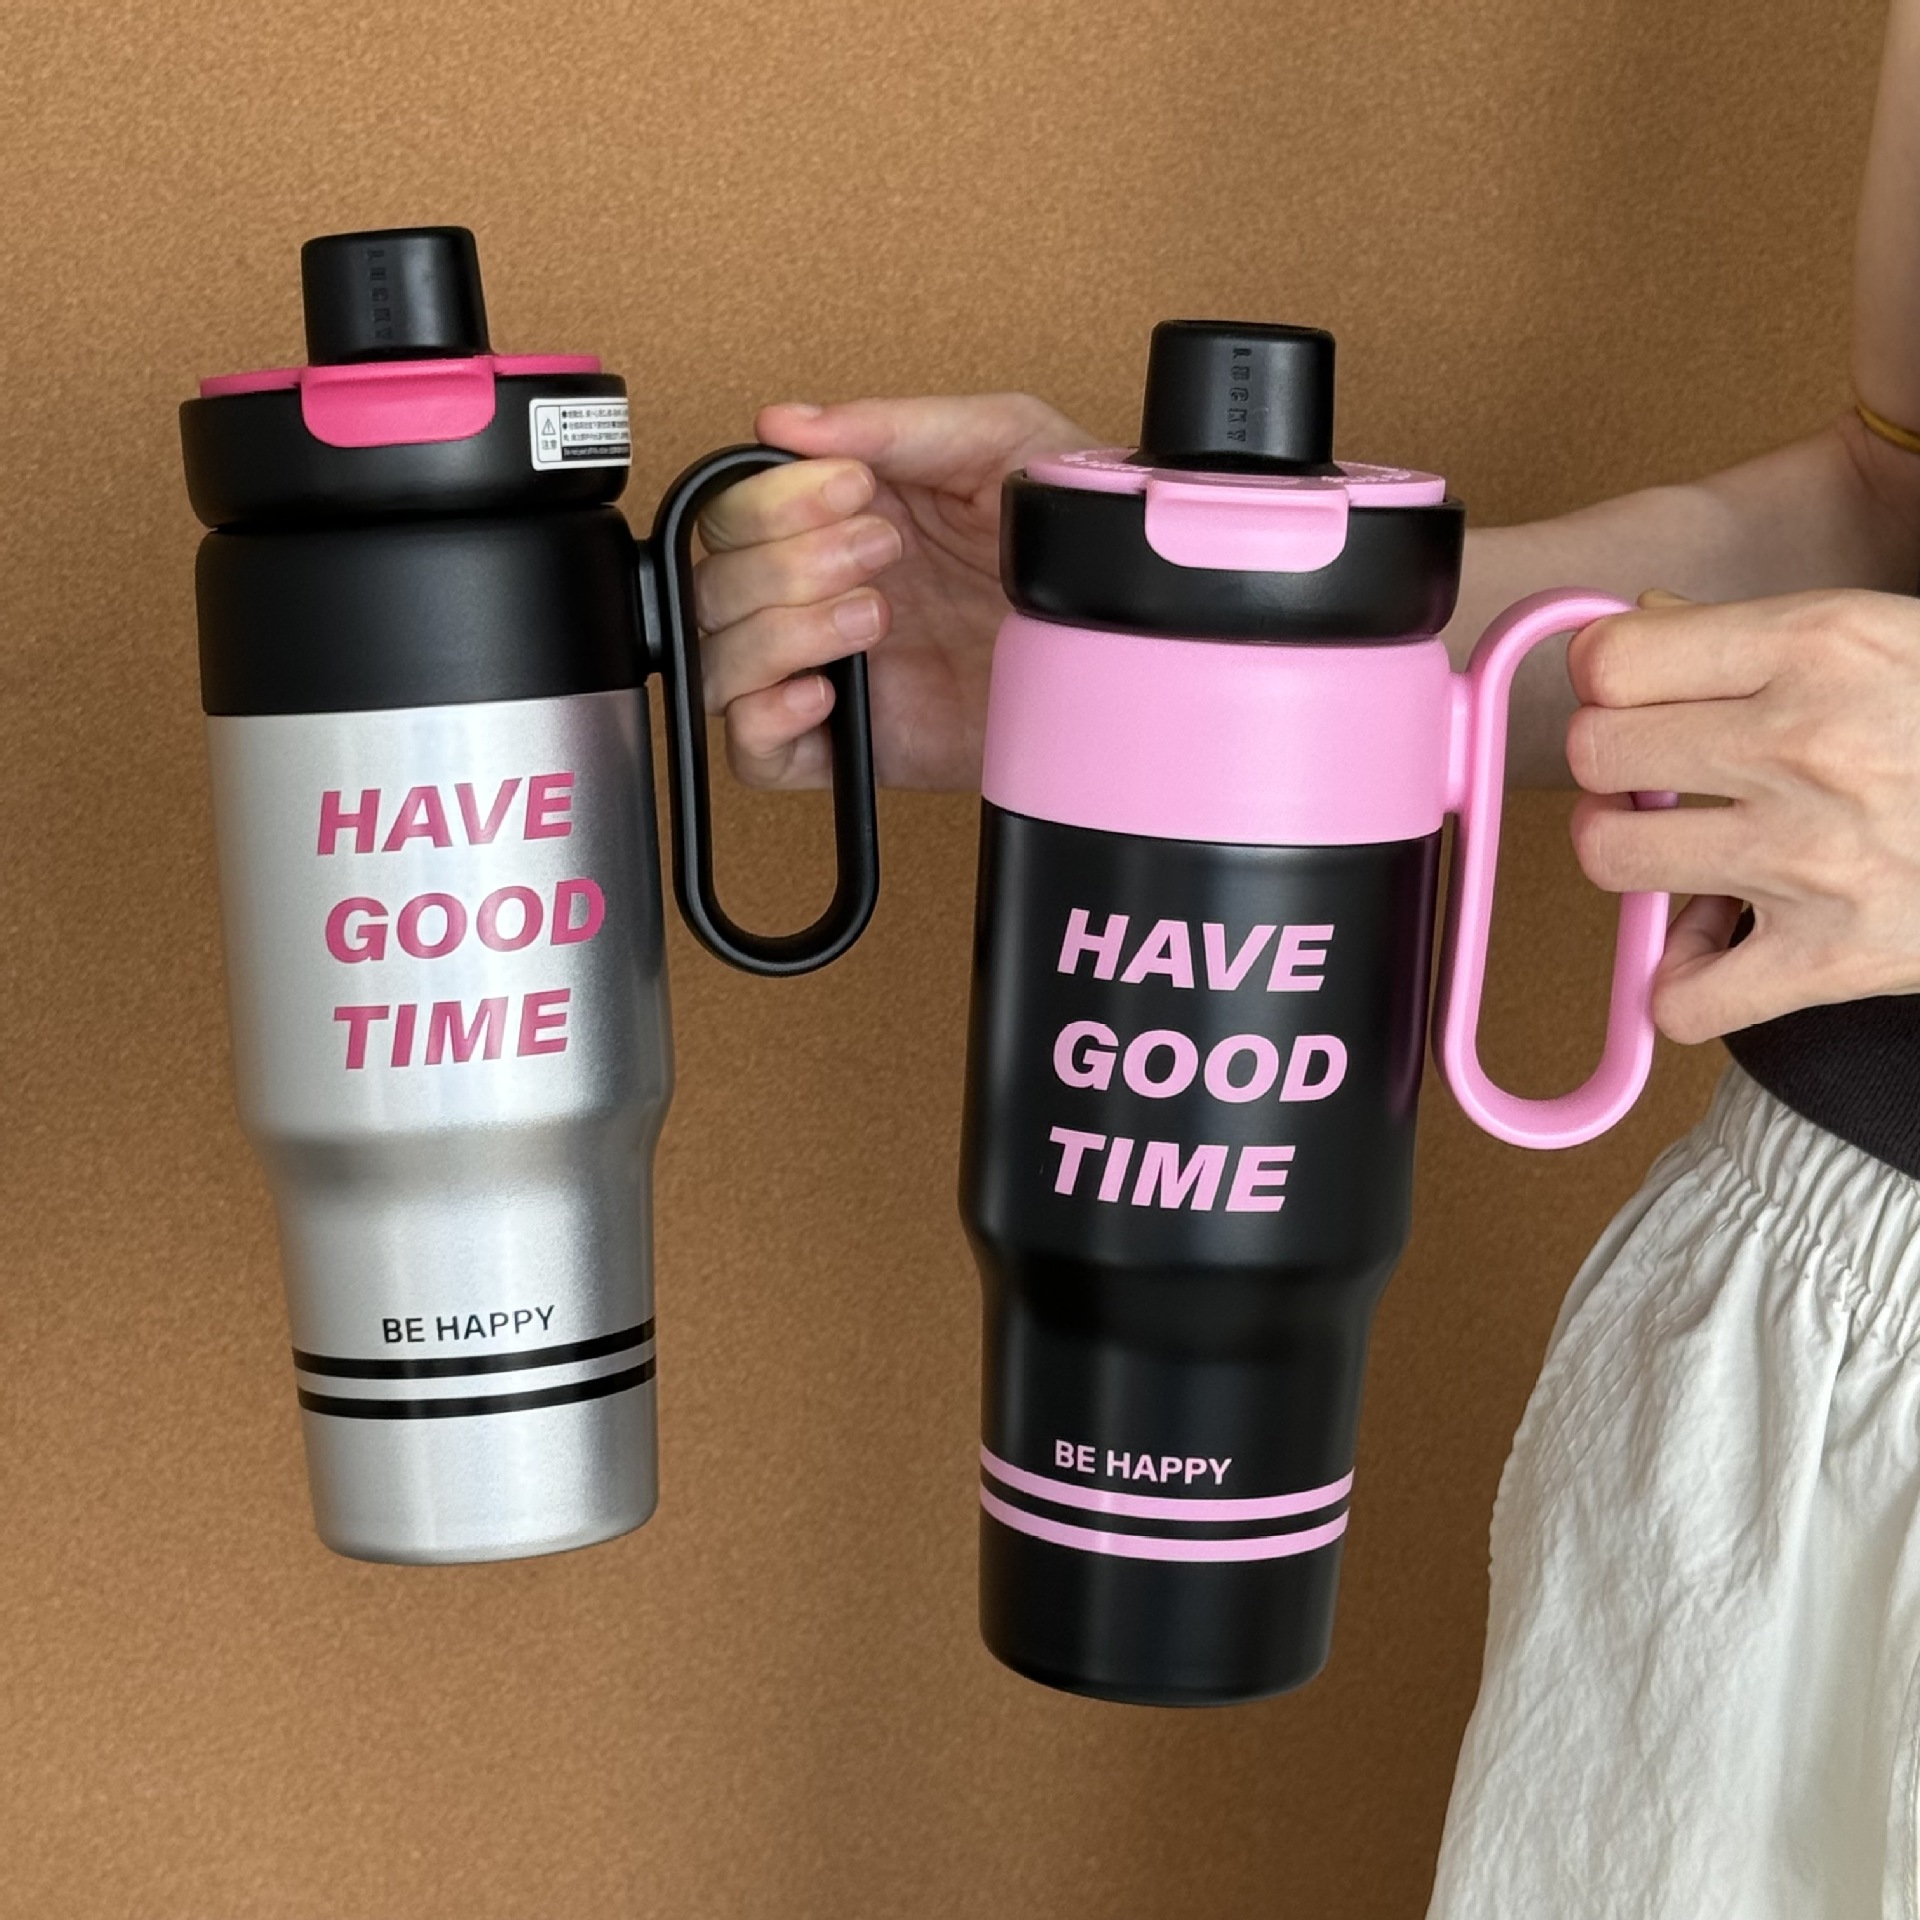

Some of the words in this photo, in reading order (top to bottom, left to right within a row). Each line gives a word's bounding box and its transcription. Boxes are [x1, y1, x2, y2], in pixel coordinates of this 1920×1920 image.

[317, 771, 575, 856] HAVE
[325, 877, 606, 964] GOOD
[1057, 907, 1334, 992] HAVE
[333, 988, 571, 1070] TIME
[1053, 1020, 1347, 1103] GOOD
[1049, 1125, 1296, 1213] TIME
[382, 1317, 426, 1344] BE
[436, 1304, 555, 1342] HAPPY
[1055, 1439, 1096, 1474] BE
[1106, 1449, 1232, 1485] HAPPY
